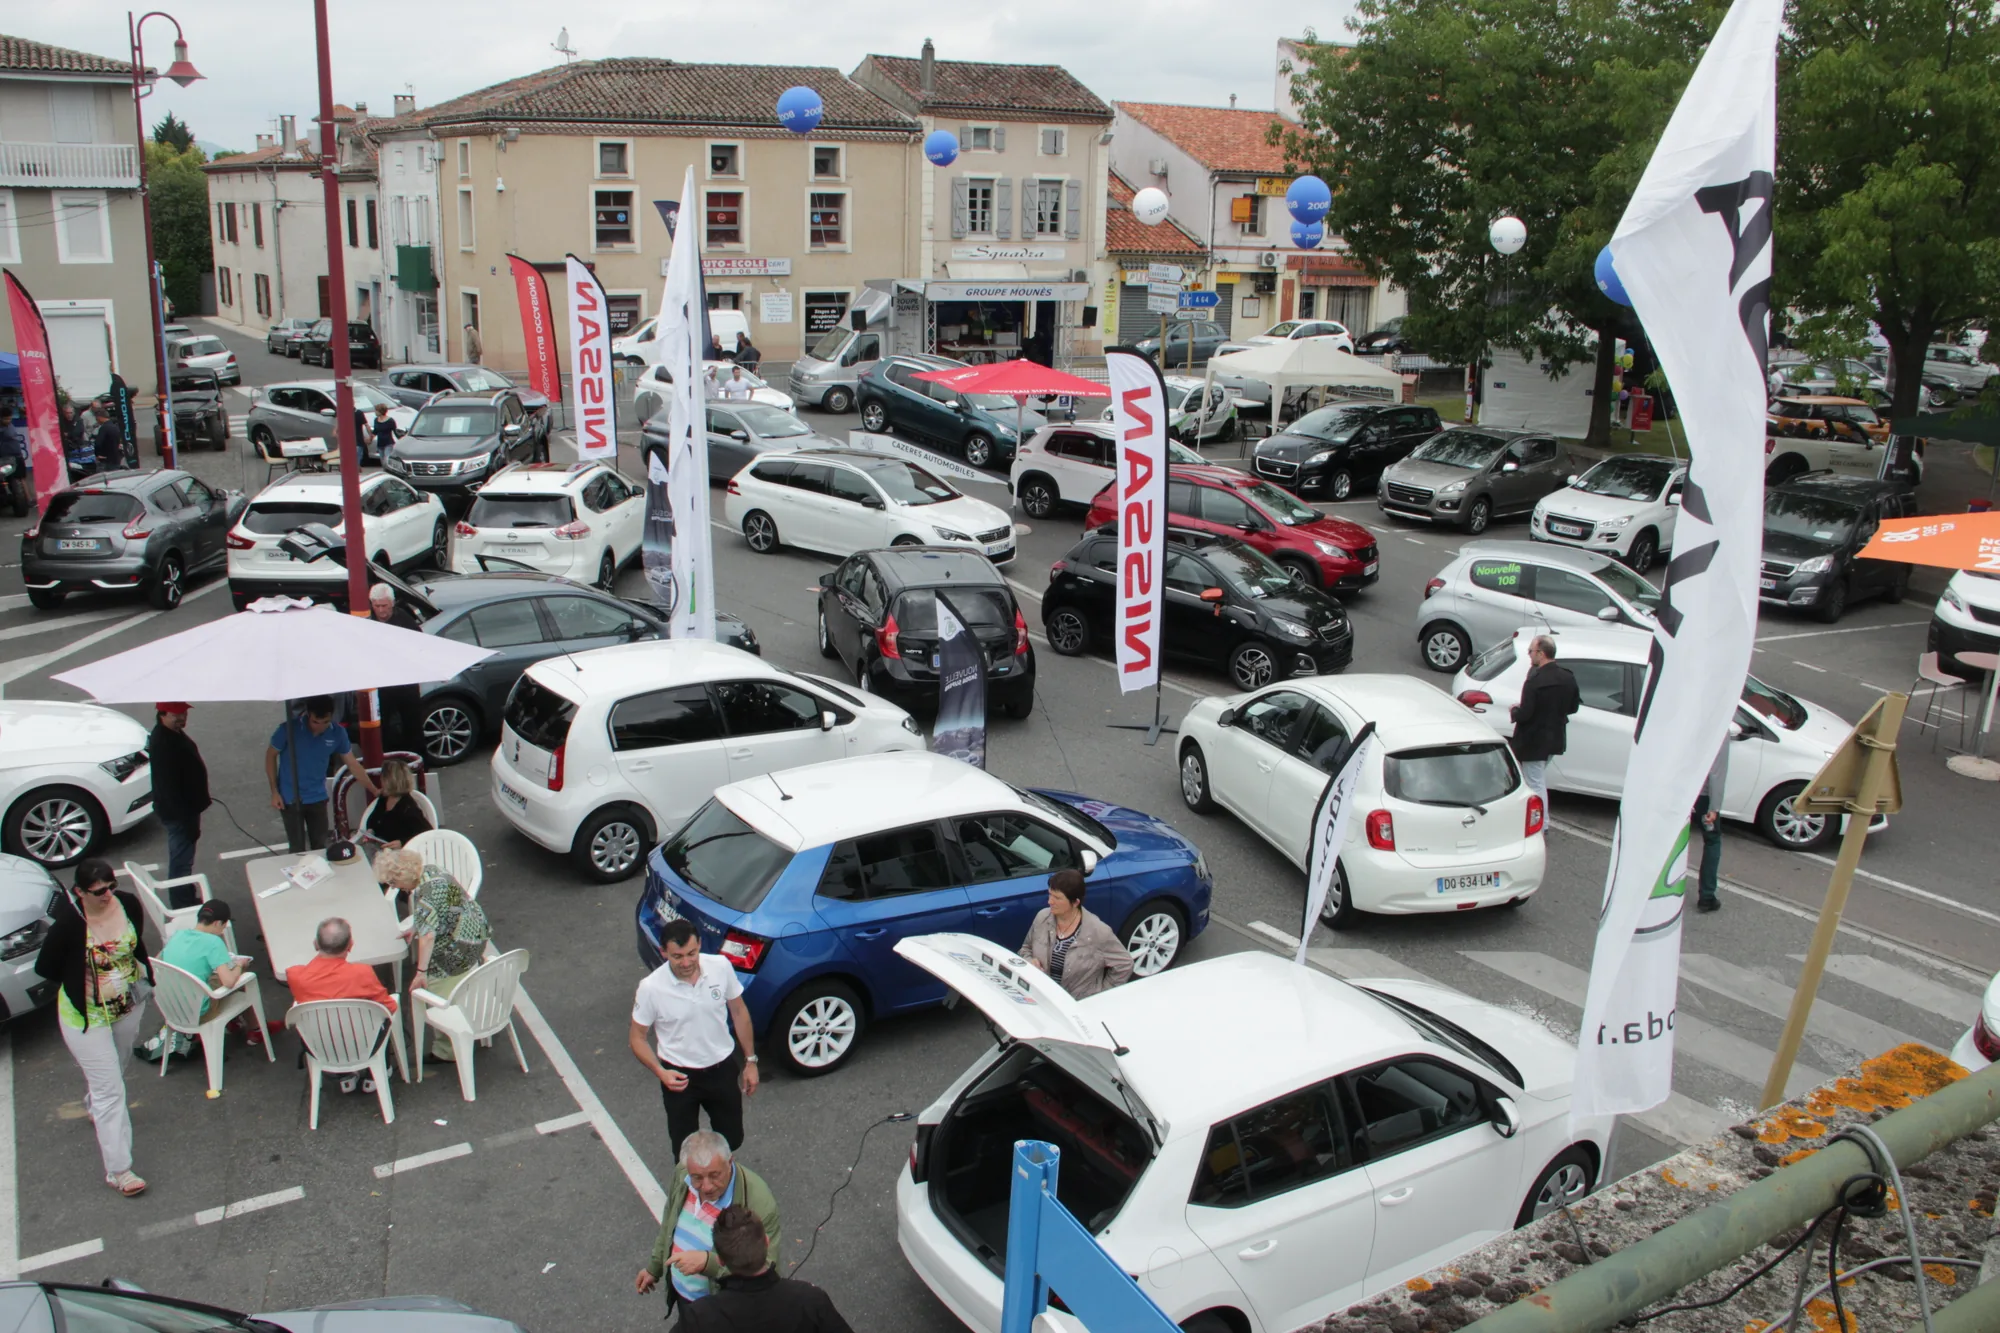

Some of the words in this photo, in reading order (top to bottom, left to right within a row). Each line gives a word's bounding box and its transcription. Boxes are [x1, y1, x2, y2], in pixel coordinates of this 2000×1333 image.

[1148, 204, 1167, 216] 2008
[969, 244, 1044, 260] Squadra
[701, 259, 767, 268] UTO-ECOLE
[965, 288, 1007, 296] GROUPE
[1010, 287, 1052, 296] MOUNÈS
[891, 440, 922, 458] CAZERES
[923, 453, 975, 479] AUTOMOBILES
[1476, 563, 1521, 576] Nouvelle
[1498, 575, 1517, 586] 108
